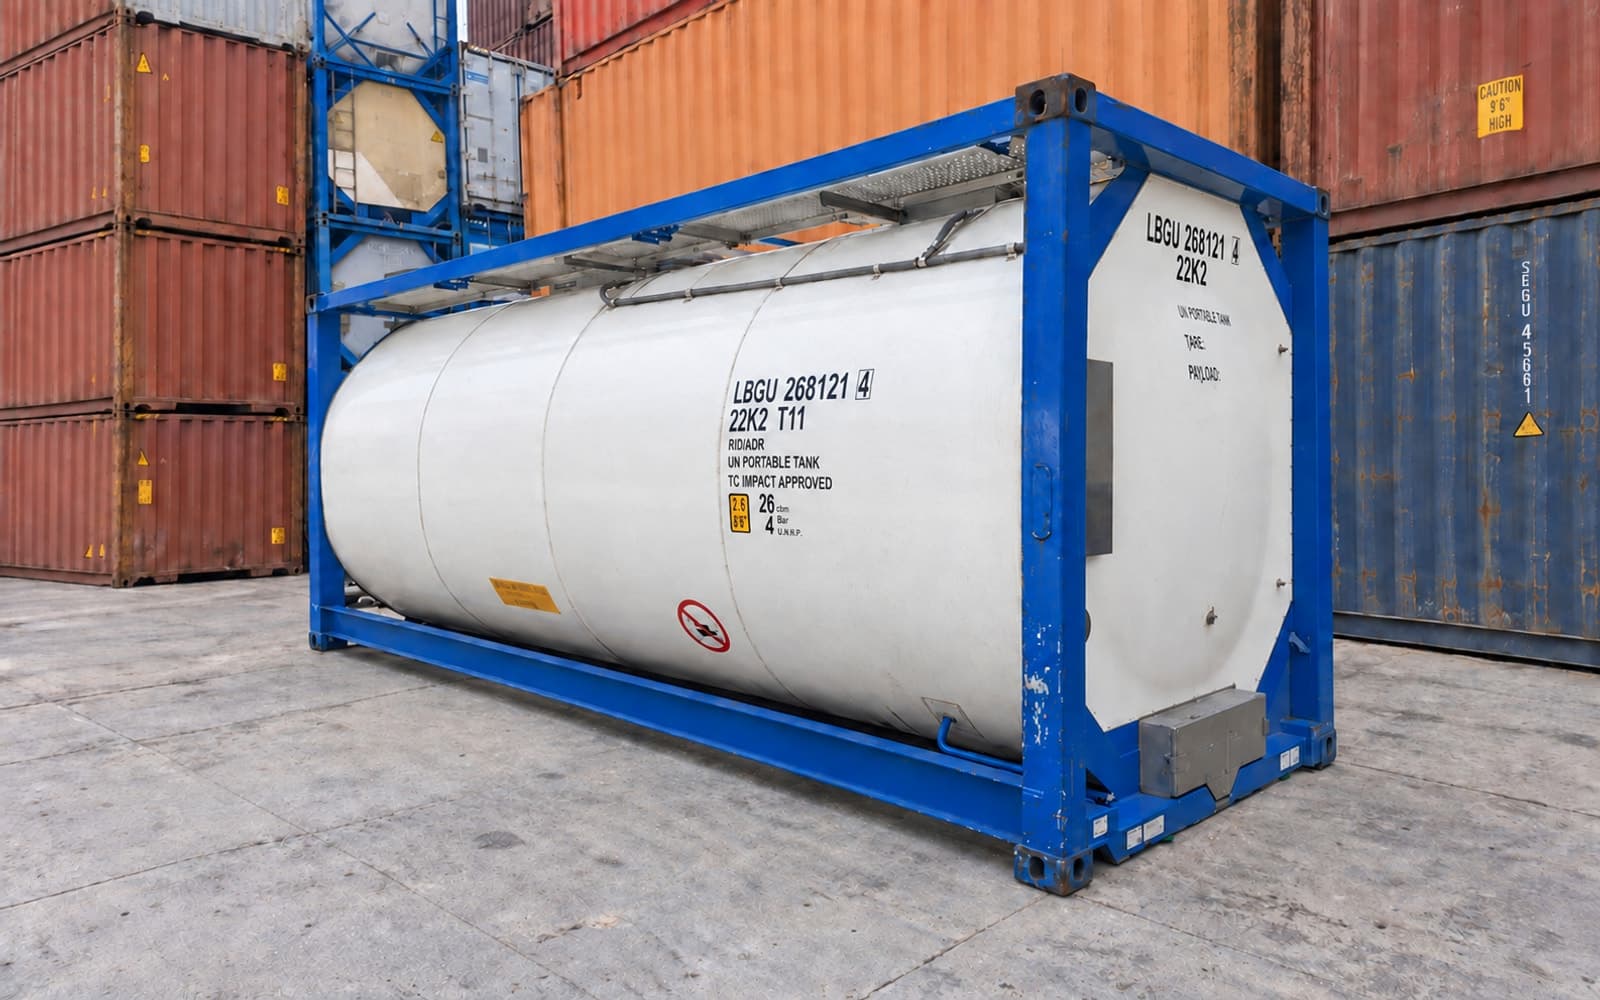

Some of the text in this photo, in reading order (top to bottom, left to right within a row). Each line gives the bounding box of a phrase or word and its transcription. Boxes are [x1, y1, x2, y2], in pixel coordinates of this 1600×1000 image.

[1480, 78, 1521, 100] CAUTION
[1489, 114, 1512, 132] HIGH
[1147, 212, 1240, 265] LBGU 268121 4
[1176, 255, 1207, 286] 22K2
[1188, 306, 1217, 324] PORTABLE
[1521, 261, 1532, 404] SEGU 45661
[733, 370, 871, 404] LBGU 268121 4
[729, 405, 806, 432] 22K2 T11
[728, 438, 765, 451] RID/ADR
[728, 456, 820, 469] UN PORTABLE TANK
[728, 475, 833, 490] TC IMPACT APPROVED
[732, 497, 746, 512] 2.6
[759, 493, 790, 514] 26 cbm
[765, 515, 789, 535] 4 Bar
